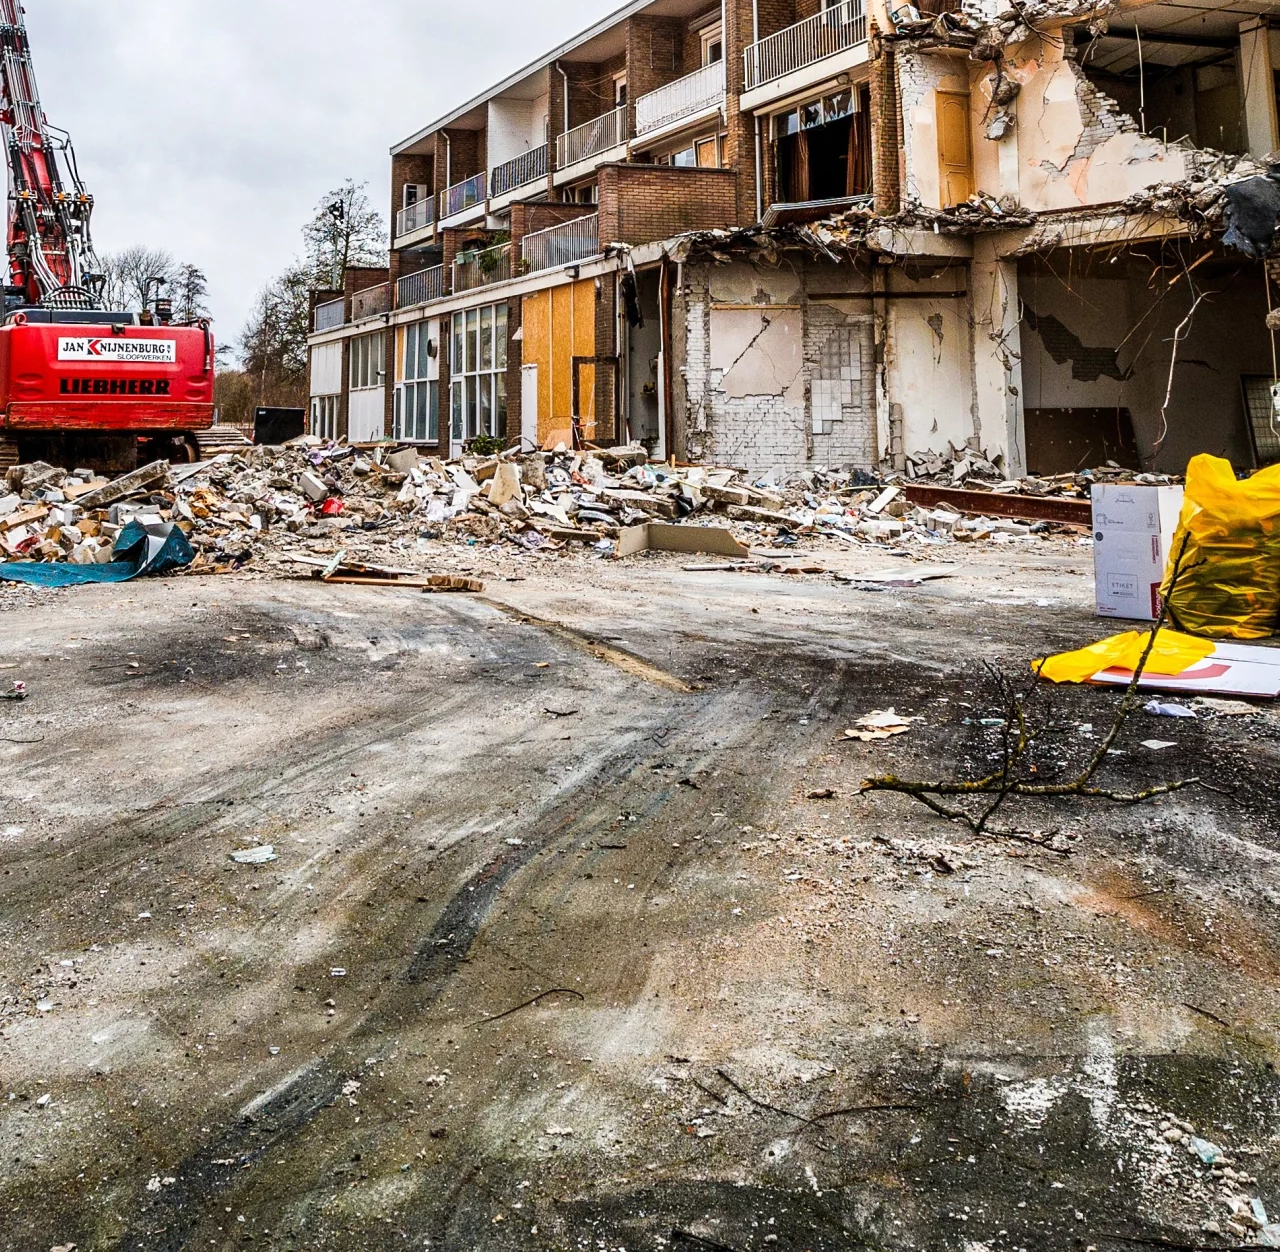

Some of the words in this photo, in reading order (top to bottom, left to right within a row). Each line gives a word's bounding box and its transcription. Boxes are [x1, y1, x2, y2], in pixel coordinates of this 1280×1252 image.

[63, 342, 84, 352] JAN
[87, 339, 166, 356] KNIJNENBURG
[117, 353, 172, 361] SLOOPWERKEN
[60, 379, 170, 395] LIEBHERR
